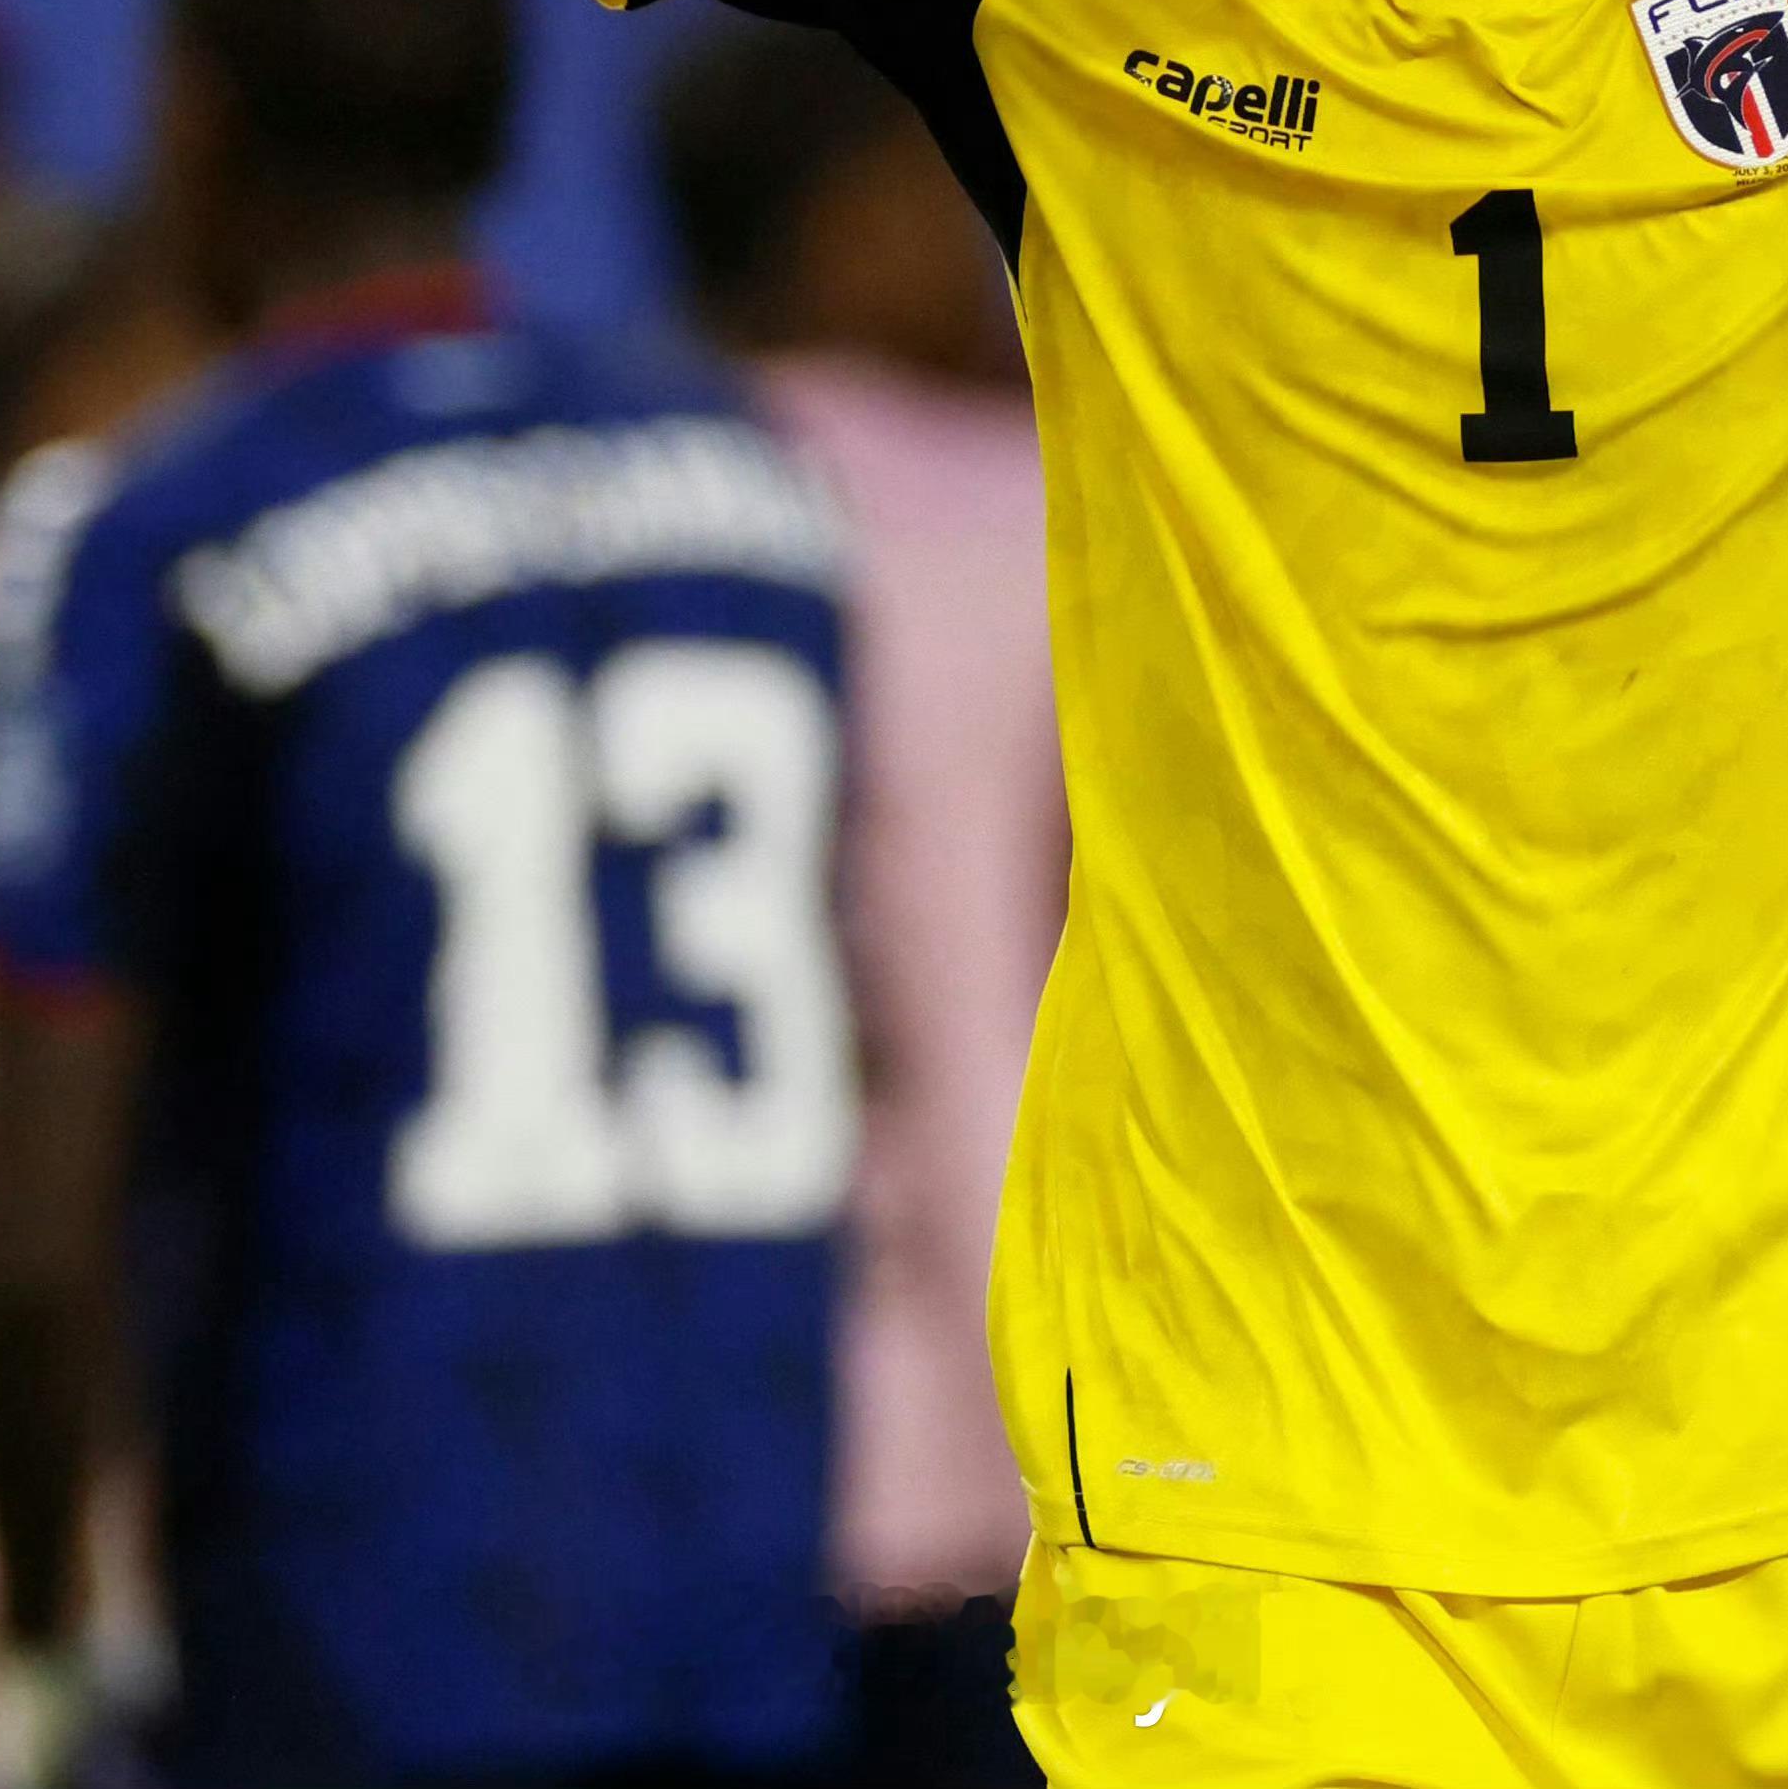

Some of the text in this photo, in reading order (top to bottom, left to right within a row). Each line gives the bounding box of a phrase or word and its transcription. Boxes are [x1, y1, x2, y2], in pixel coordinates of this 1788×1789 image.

[1123, 49, 1321, 133] capelli
[1732, 167, 1760, 177] JULY
[1449, 188, 1578, 463] 1
[383, 639, 859, 1247] 13
